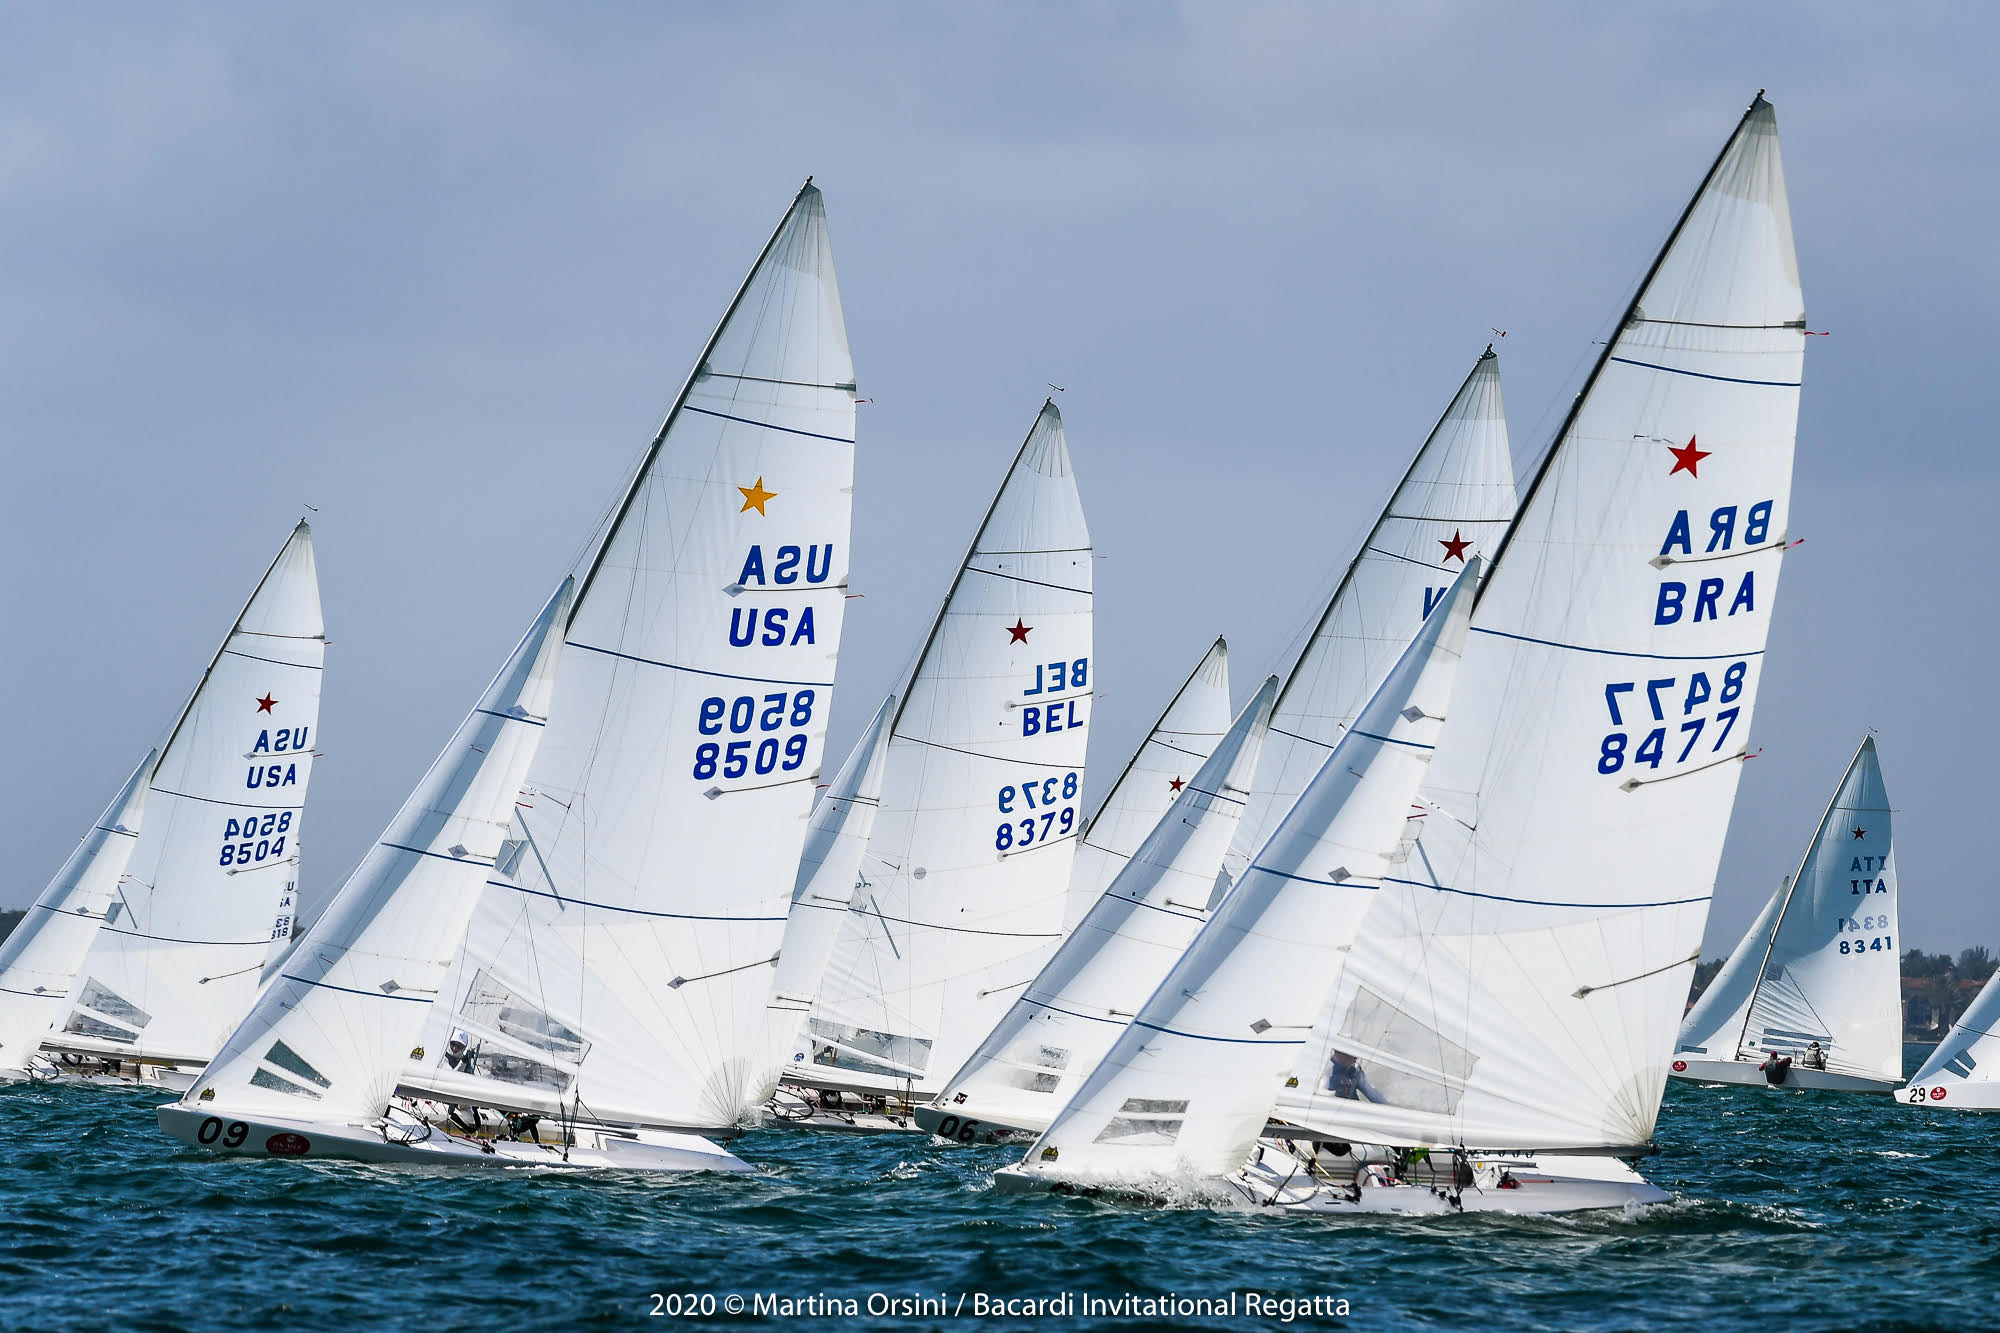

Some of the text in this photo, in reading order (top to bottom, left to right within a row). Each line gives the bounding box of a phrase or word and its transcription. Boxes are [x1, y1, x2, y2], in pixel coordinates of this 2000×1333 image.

[1654, 570, 1754, 626] BRA
[729, 606, 816, 648] USA
[1022, 700, 1083, 737] BEL
[693, 733, 808, 781] 8509
[1597, 706, 1740, 775] 8477
[246, 763, 296, 789] USA
[995, 807, 1074, 851] 8379
[219, 836, 285, 867] 8504
[1850, 878, 1888, 895] ITA
[1839, 935, 1892, 955] 8341
[1909, 1087, 1926, 1103] 29
[197, 1116, 250, 1149] 09
[938, 1115, 980, 1142] 06
